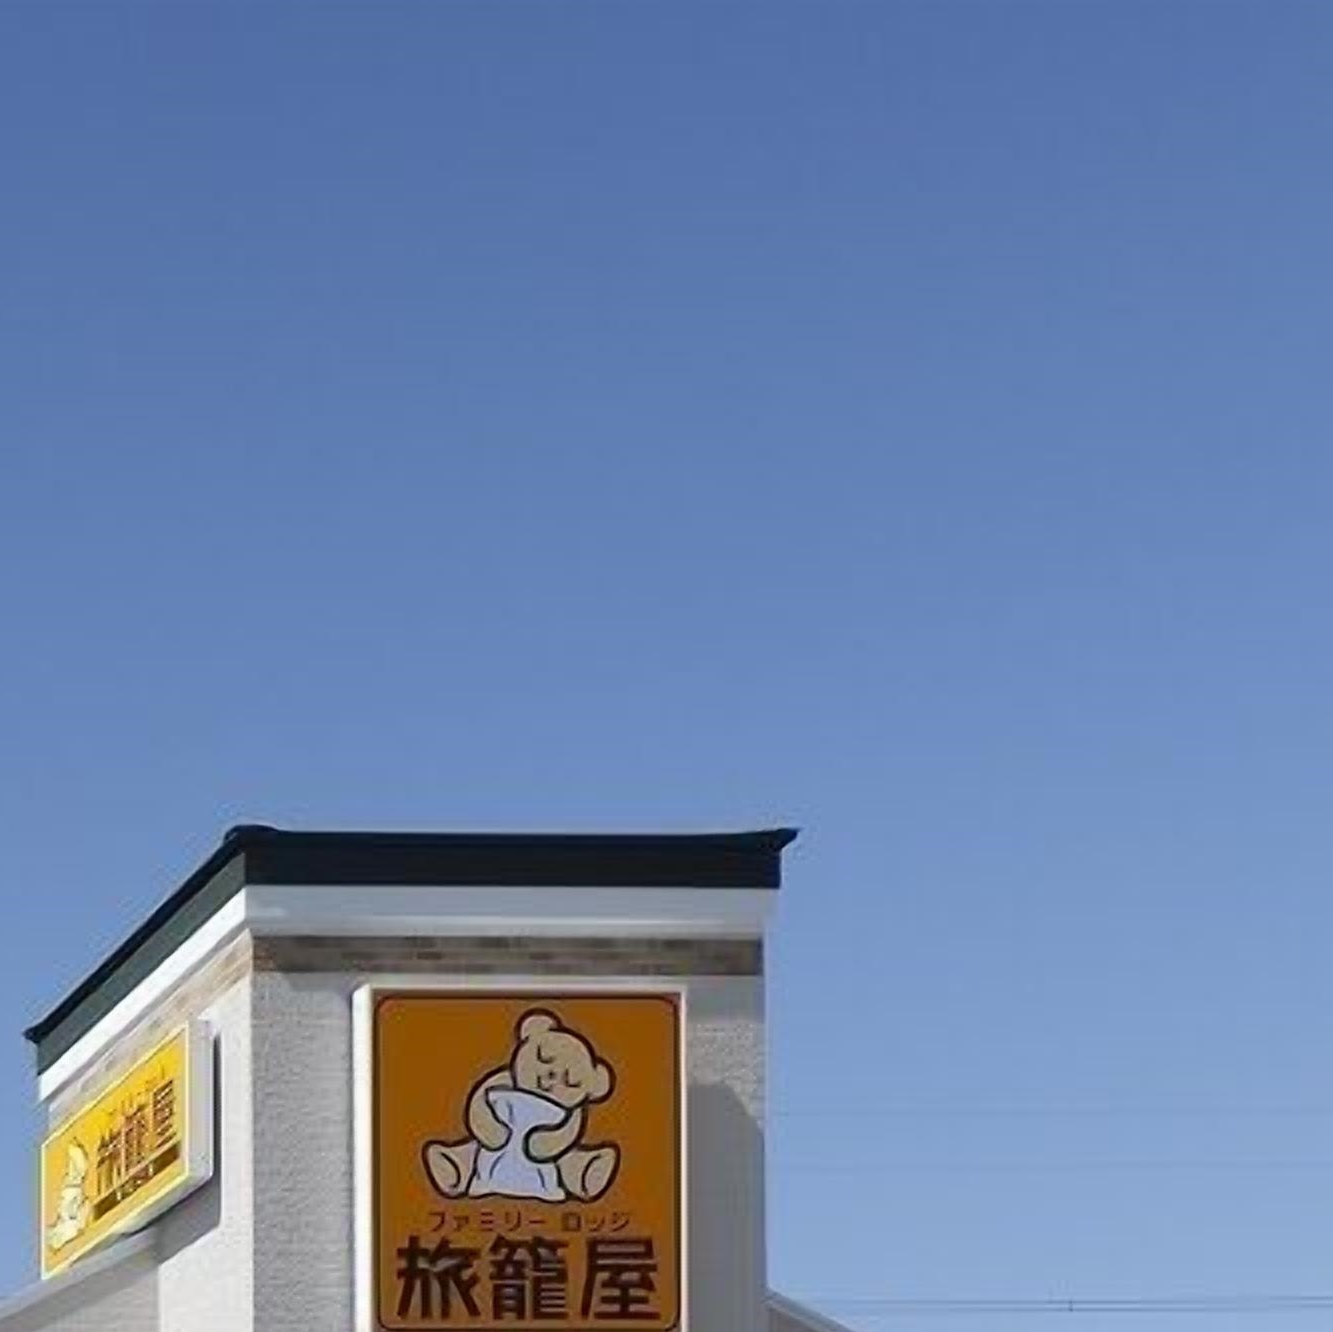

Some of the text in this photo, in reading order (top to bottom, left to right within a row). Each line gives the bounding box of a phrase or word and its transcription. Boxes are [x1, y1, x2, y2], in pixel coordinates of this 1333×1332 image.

[430, 1211, 630, 1232] ファミリー ロッジ
[396, 1234, 661, 1321] 旅籠屋
